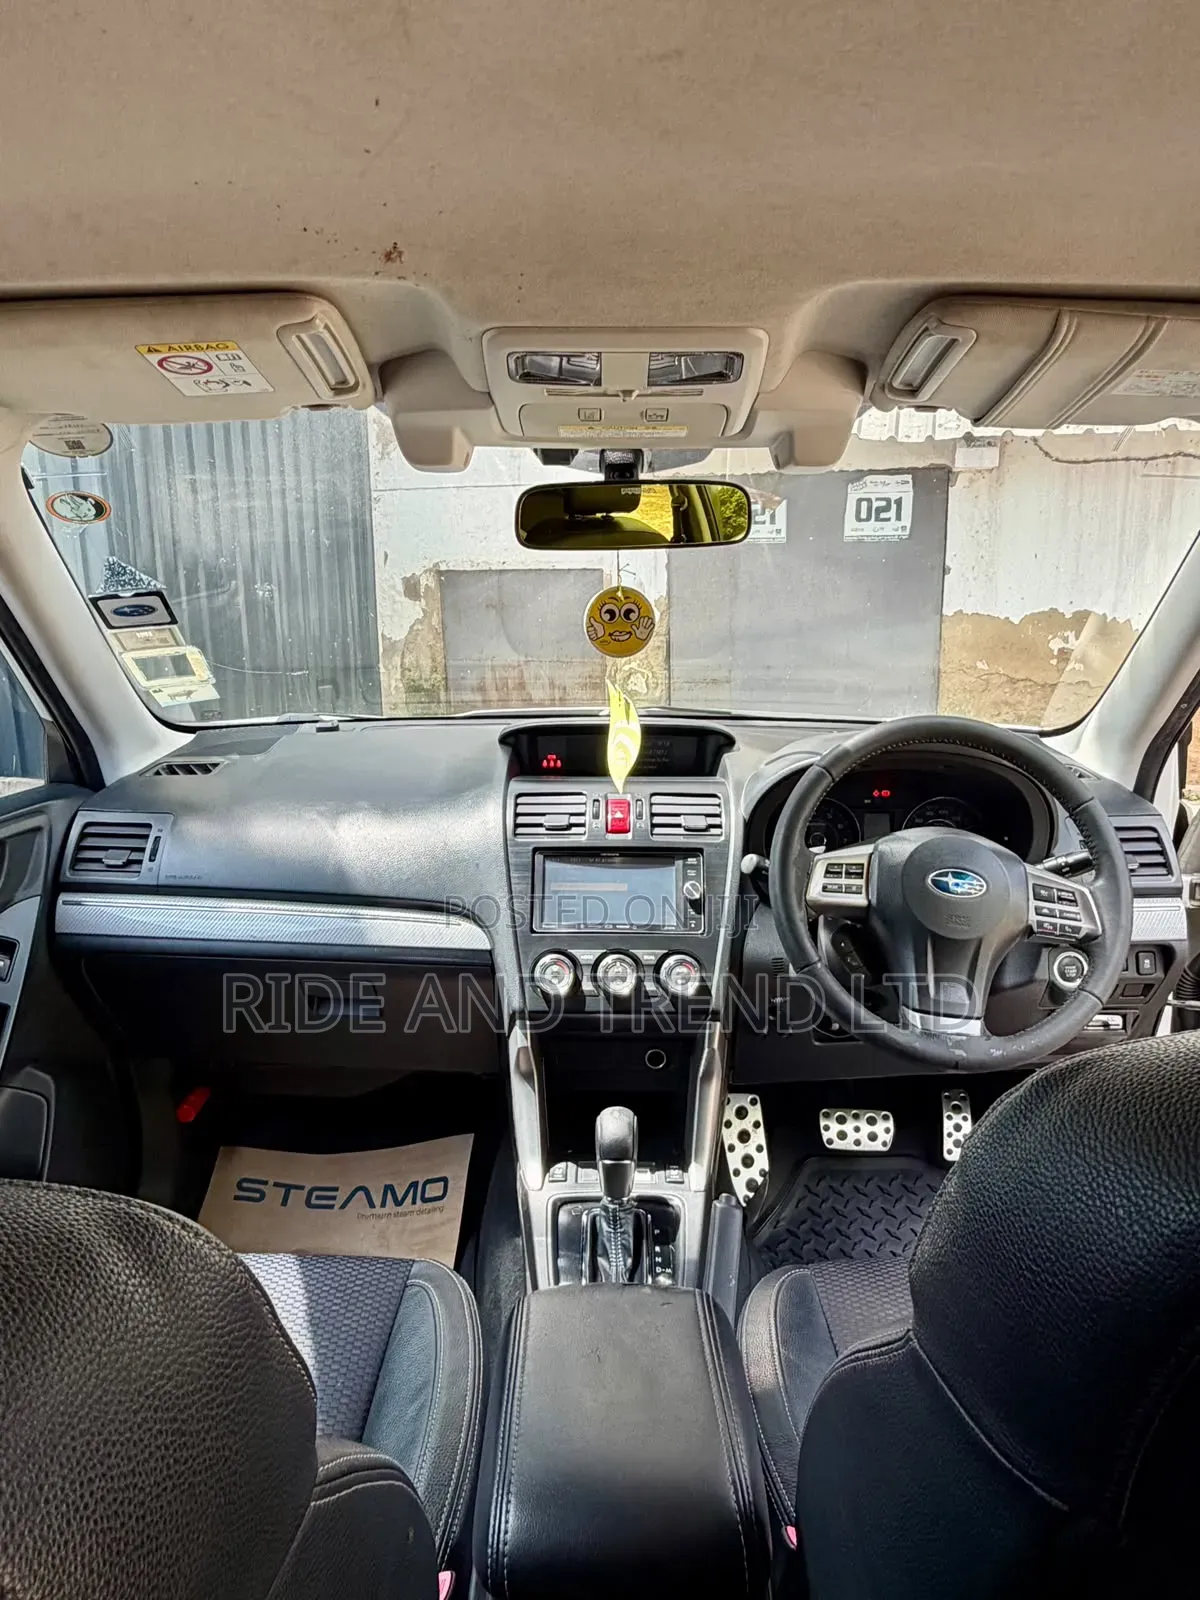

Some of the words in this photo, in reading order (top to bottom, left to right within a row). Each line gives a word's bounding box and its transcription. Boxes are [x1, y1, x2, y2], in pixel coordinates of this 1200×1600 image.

[167, 343, 229, 352] AIRBAG
[855, 496, 903, 523] 021
[233, 1176, 450, 1210] STEAMO
[393, 1206, 415, 1219] steam
[415, 1201, 445, 1217] detailing
